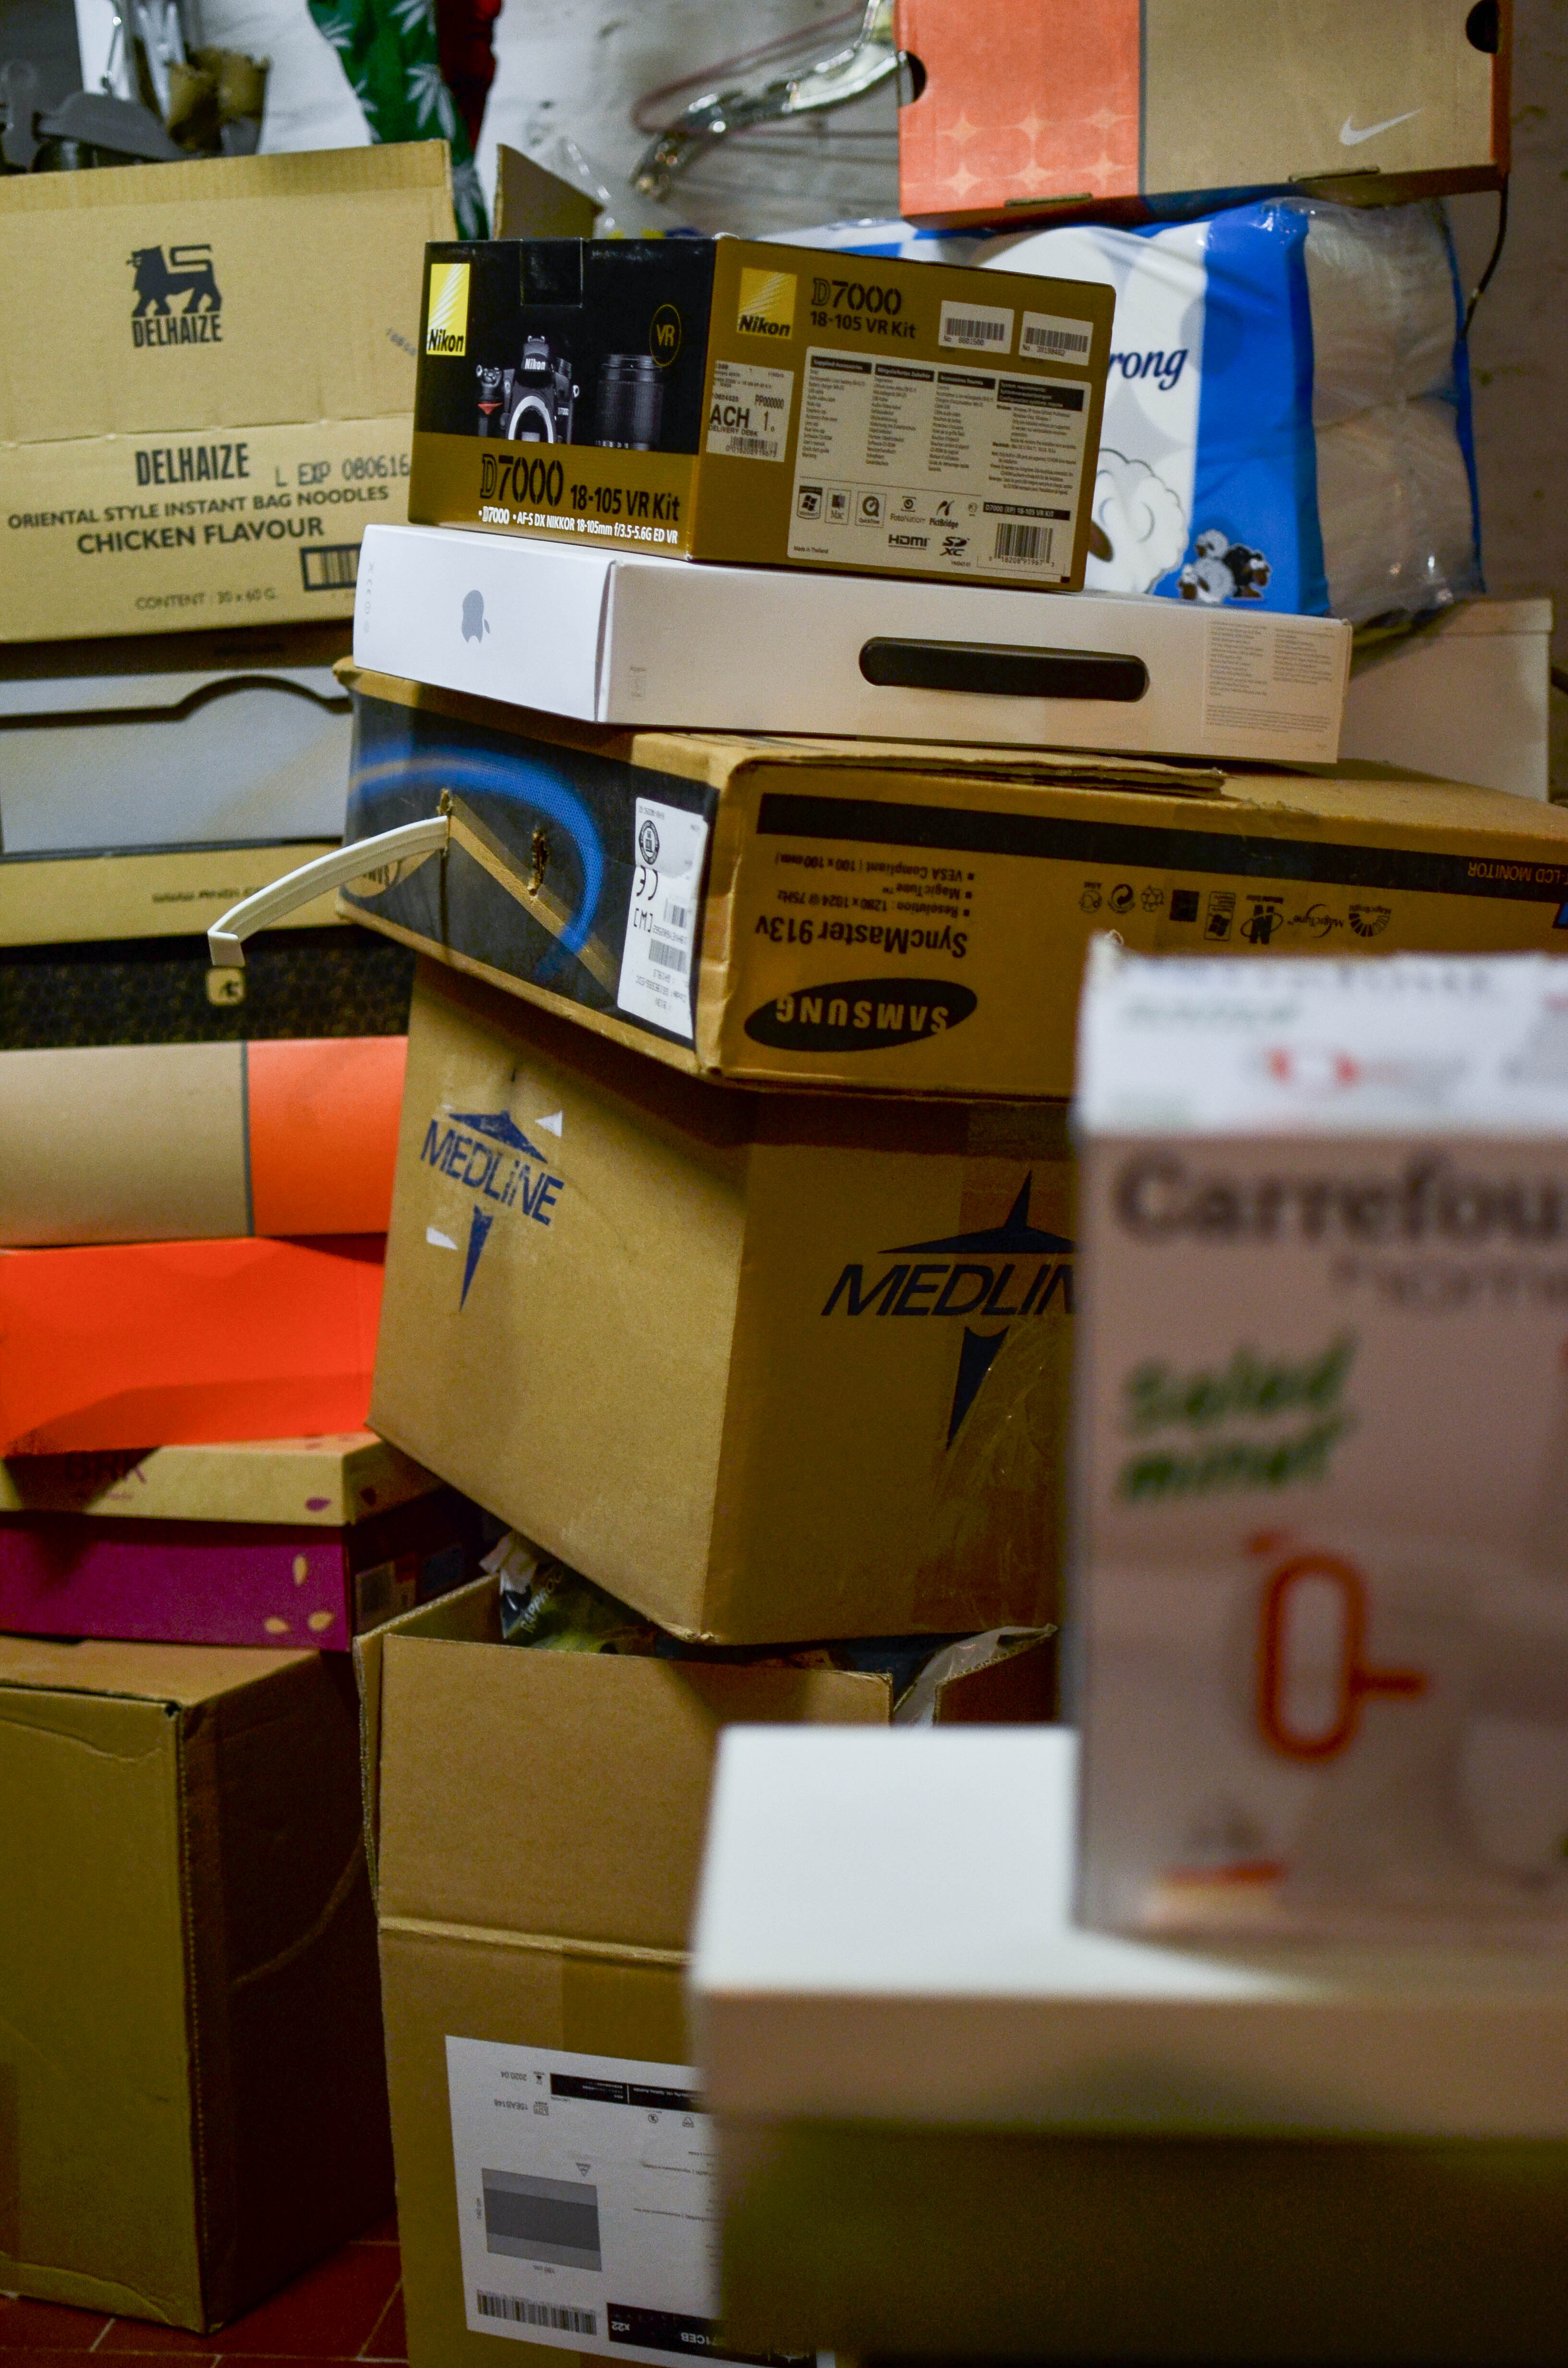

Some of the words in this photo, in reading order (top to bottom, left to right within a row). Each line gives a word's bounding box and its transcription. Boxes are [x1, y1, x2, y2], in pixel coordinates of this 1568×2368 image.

[811, 277, 902, 315] D7000
[131, 314, 223, 348] DELHAIZE
[656, 326, 674, 346] VR
[739, 315, 791, 336] Nikon
[810, 310, 862, 332] 18-105
[866, 318, 888, 335] VR
[891, 321, 916, 339] Kit
[427, 329, 465, 352] Nikon
[525, 358, 546, 370] Nikon
[710, 404, 750, 429] ACH
[135, 443, 250, 486] DELHAIZE
[298, 460, 331, 486] EXP
[479, 453, 564, 507] D7000
[8, 507, 99, 529] ORIENTAL
[105, 502, 159, 522] STYLE
[164, 496, 246, 517] INSTANT
[253, 493, 292, 510] BAG
[297, 485, 390, 507] NOODLES
[570, 483, 624, 516] 18-105
[625, 490, 650, 518] VR
[653, 492, 680, 522] Kit
[831, 510, 844, 519] Mac
[77, 524, 196, 555] CHICKEN
[204, 516, 325, 543] FLAVOUR
[482, 506, 510, 525] D7000
[516, 511, 534, 526] AF-S
[534, 513, 546, 527] DX
[546, 515, 576, 532] NIKKOR
[576, 518, 613, 536] 18-105mm
[613, 522, 652, 542] f/3.5-5.6G
[653, 527, 665, 543] ED
[665, 529, 678, 544] VR
[929, 518, 959, 529] PictBridge
[888, 534, 929, 547] HDMI
[135, 592, 205, 610] CONTENT
[865, 861, 929, 879] Compliant
[931, 868, 962, 882] VESA
[1467, 861, 1533, 881] MONITOR
[895, 902, 959, 918] Resolution
[755, 914, 813, 945] 913v
[818, 919, 968, 958] SyncMaster
[774, 996, 949, 1035] SAMSUNG
[820, 1263, 1079, 1317] MEDLIN
[610, 2320, 631, 2332] x22
